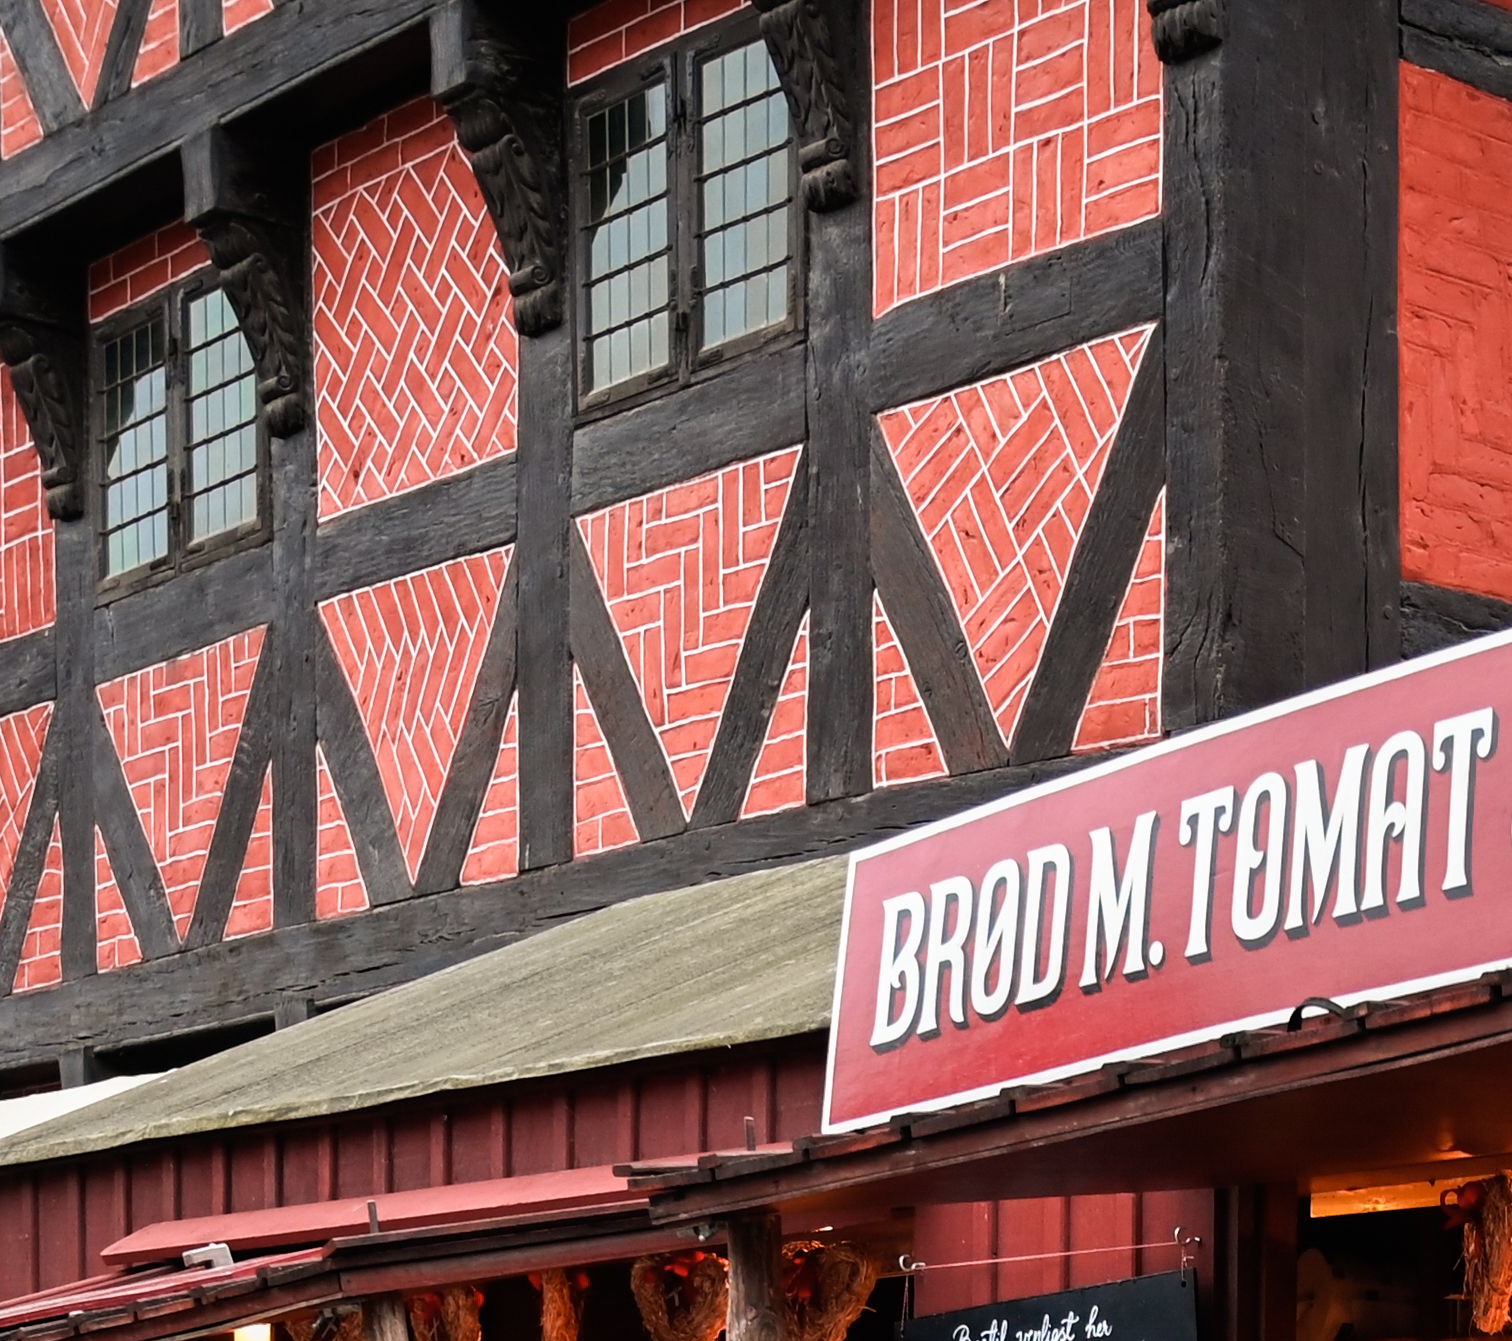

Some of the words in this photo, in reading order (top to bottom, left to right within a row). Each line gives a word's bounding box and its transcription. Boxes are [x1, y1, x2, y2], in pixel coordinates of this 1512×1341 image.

[869, 842, 1070, 1050] BRØD
[1085, 810, 1164, 990] M.
[1178, 706, 1494, 961] TOMAT
[1085, 1305, 1113, 1339] her
